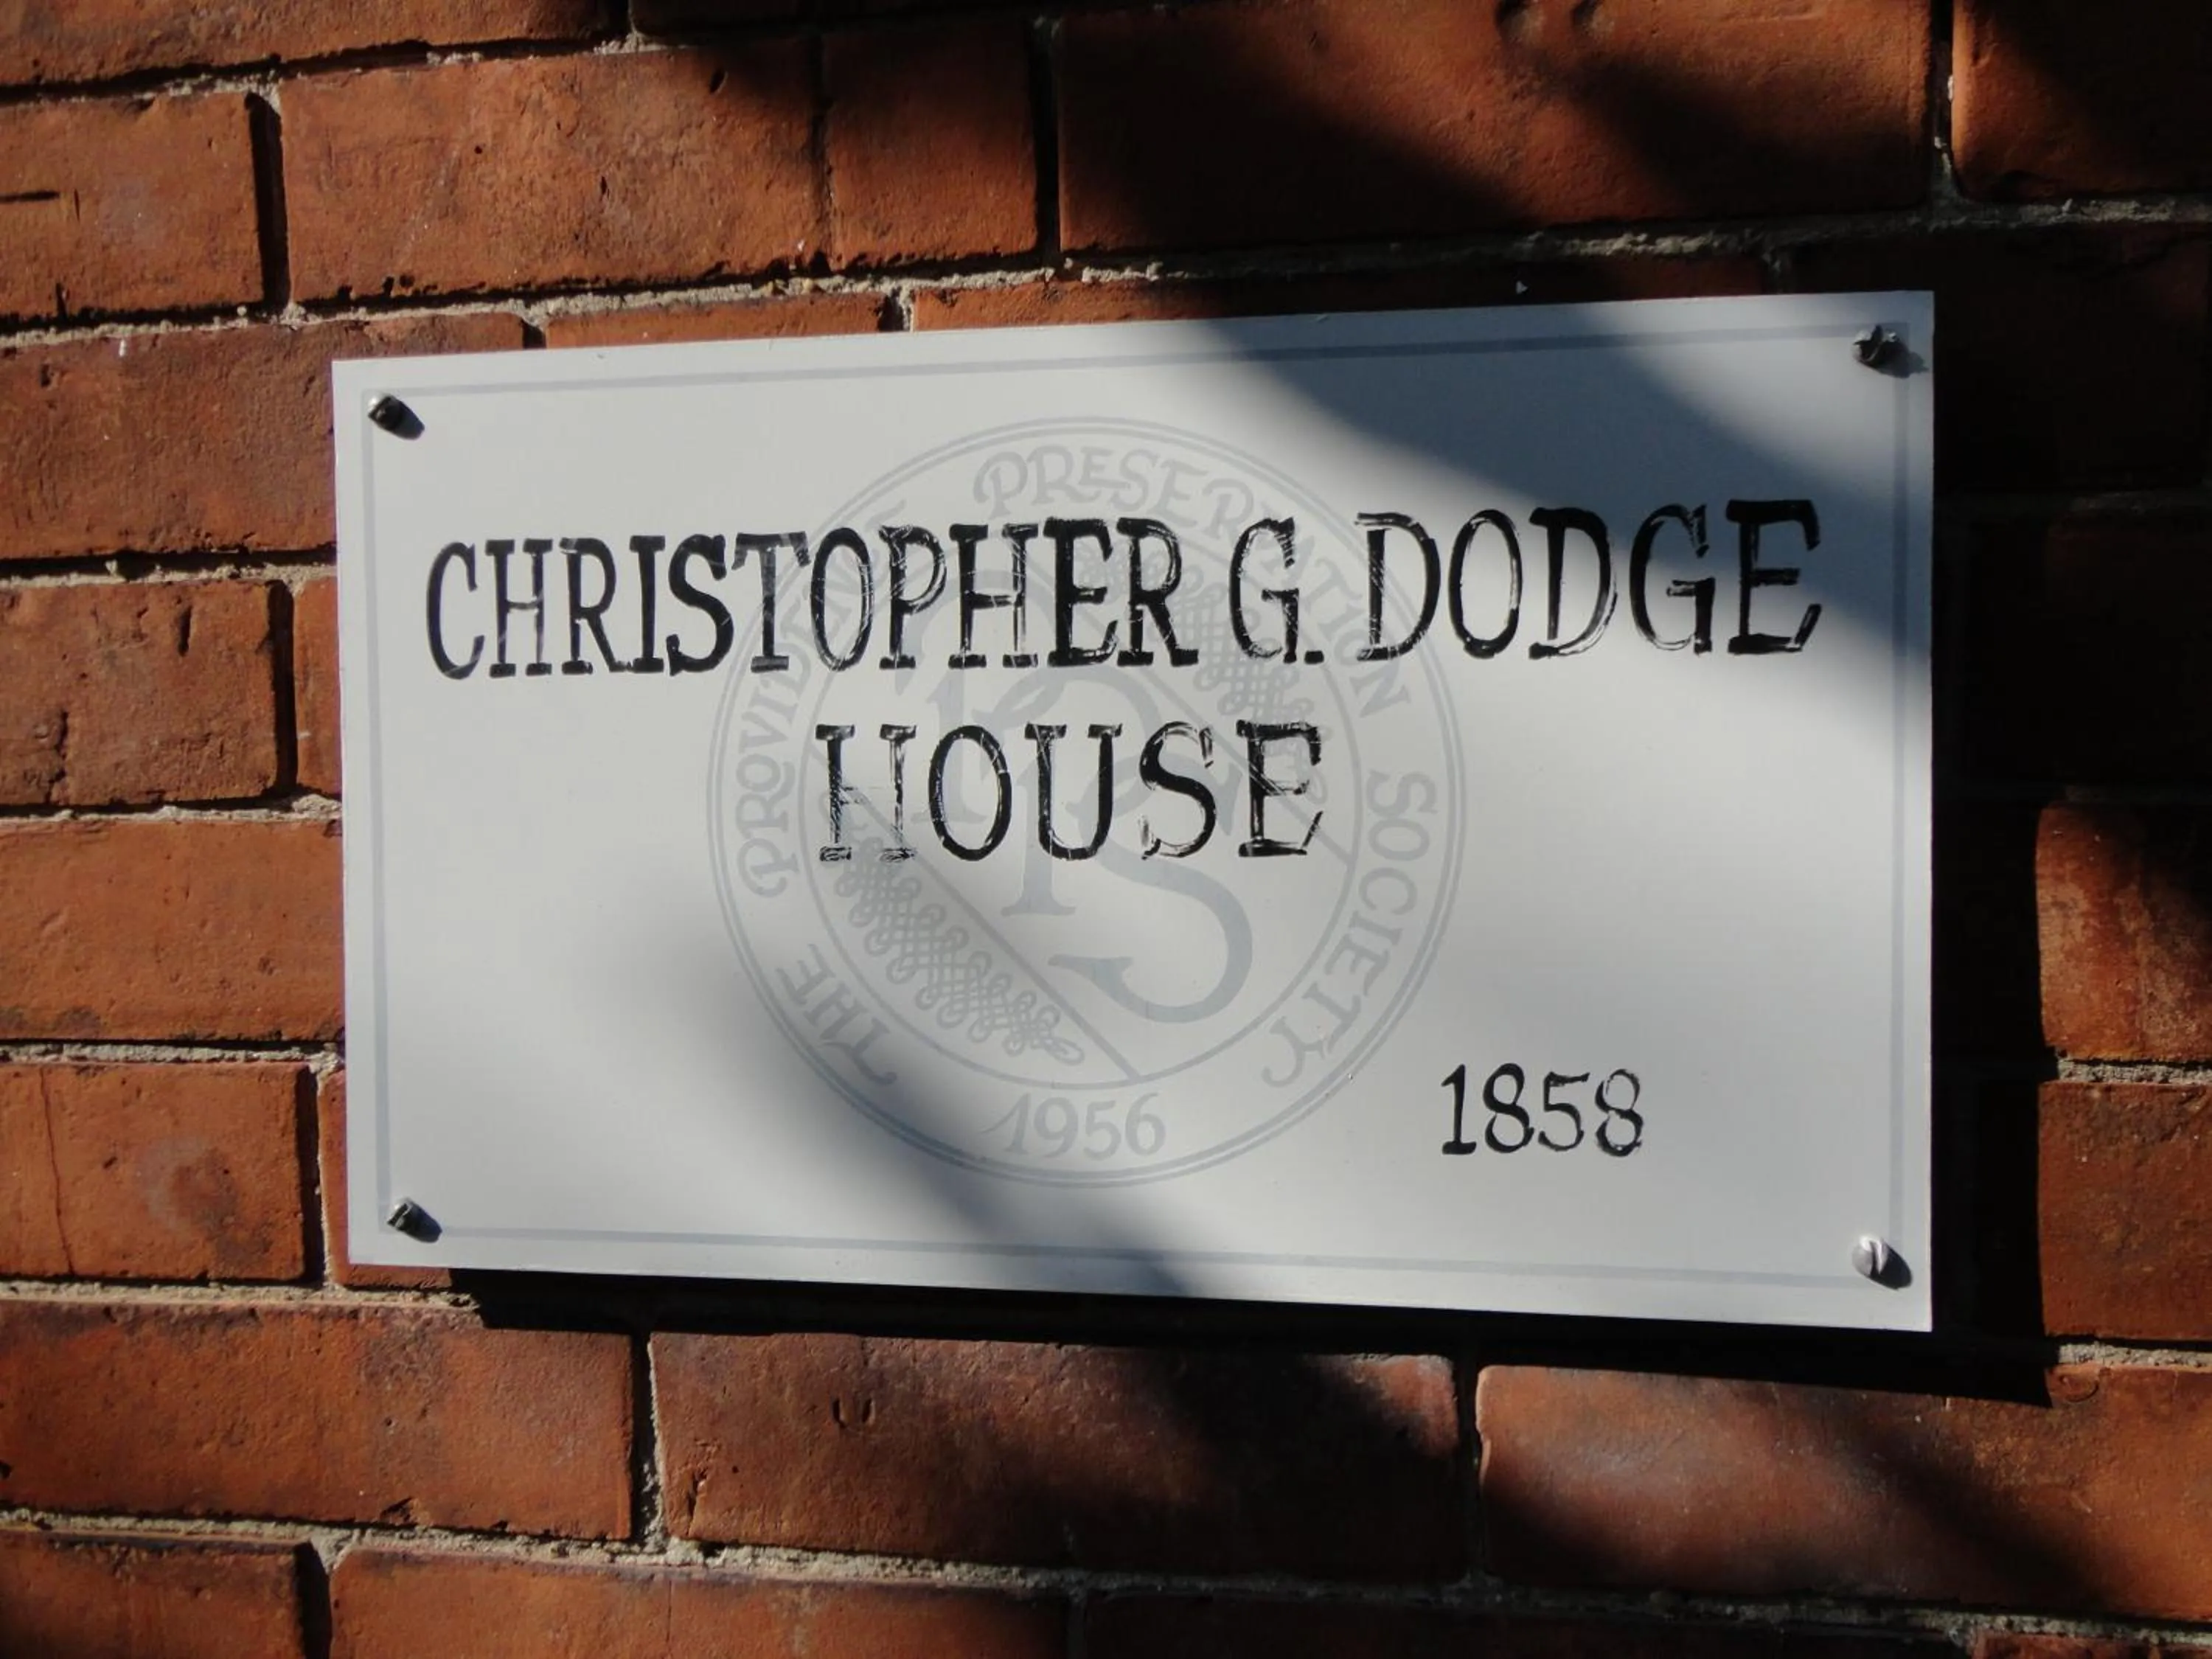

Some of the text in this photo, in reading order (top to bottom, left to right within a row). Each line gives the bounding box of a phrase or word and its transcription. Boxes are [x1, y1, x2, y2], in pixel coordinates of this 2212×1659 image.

[425, 498, 1823, 680] CHRISTOPHER G. DODGE
[815, 719, 1324, 862] HOUSE
[776, 942, 898, 1088] THE
[1261, 769, 1438, 1088] SOCIETY
[979, 1091, 1166, 1161] 1956
[1440, 1062, 1644, 1158] 1858
